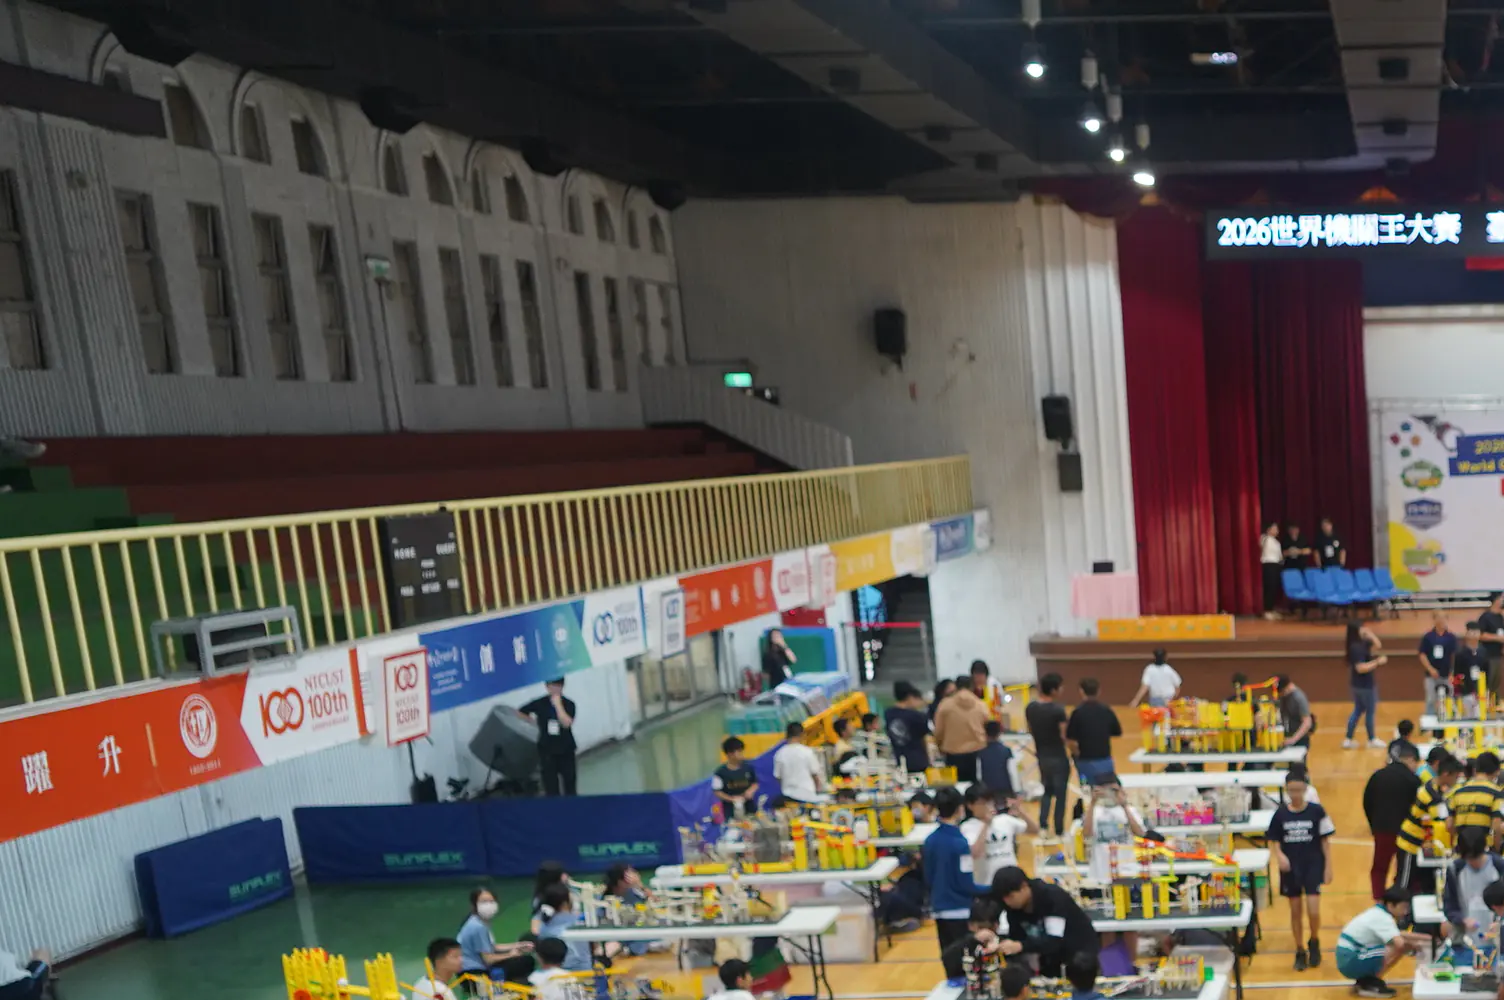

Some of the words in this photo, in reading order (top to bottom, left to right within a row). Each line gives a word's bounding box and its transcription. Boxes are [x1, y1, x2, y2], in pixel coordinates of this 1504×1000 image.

[1217, 211, 1462, 247] 2026世界機關王大賽
[1457, 458, 1496, 473] World
[308, 688, 349, 720] 100th
